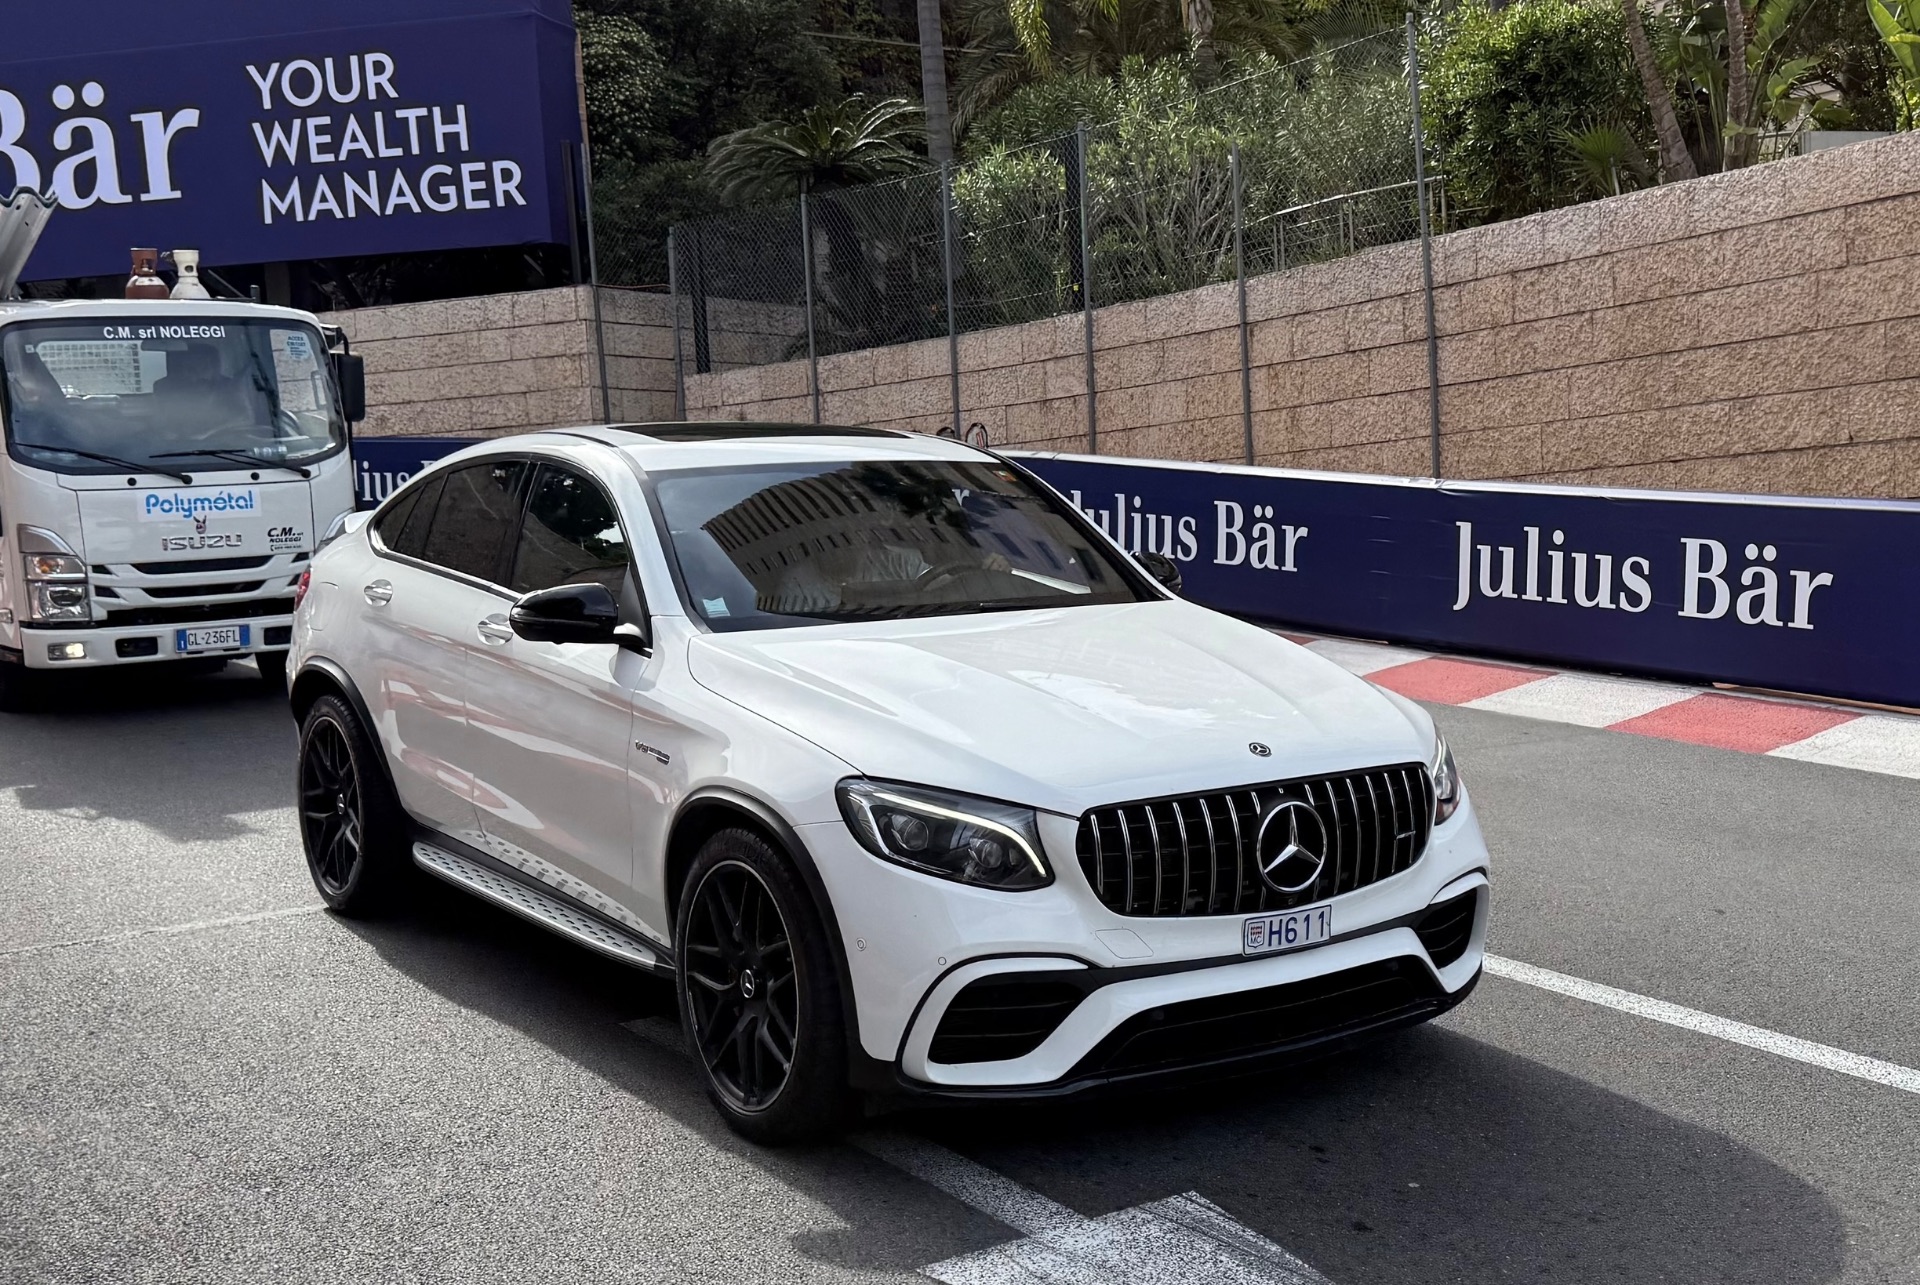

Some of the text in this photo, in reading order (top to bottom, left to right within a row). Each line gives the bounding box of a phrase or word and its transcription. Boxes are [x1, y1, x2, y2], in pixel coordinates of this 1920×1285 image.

[246, 52, 398, 109] YOUR
[252, 104, 469, 167] WEALTH
[261, 160, 527, 224] MANAGER
[103, 326, 135, 339] C.M.
[159, 325, 226, 338] NOLEGGI
[145, 490, 254, 519] Polymétal
[161, 534, 242, 551] ISUZU
[1213, 500, 1309, 572] Bär
[1453, 521, 1834, 630] Julius Bär
[1267, 910, 1325, 947] H611
